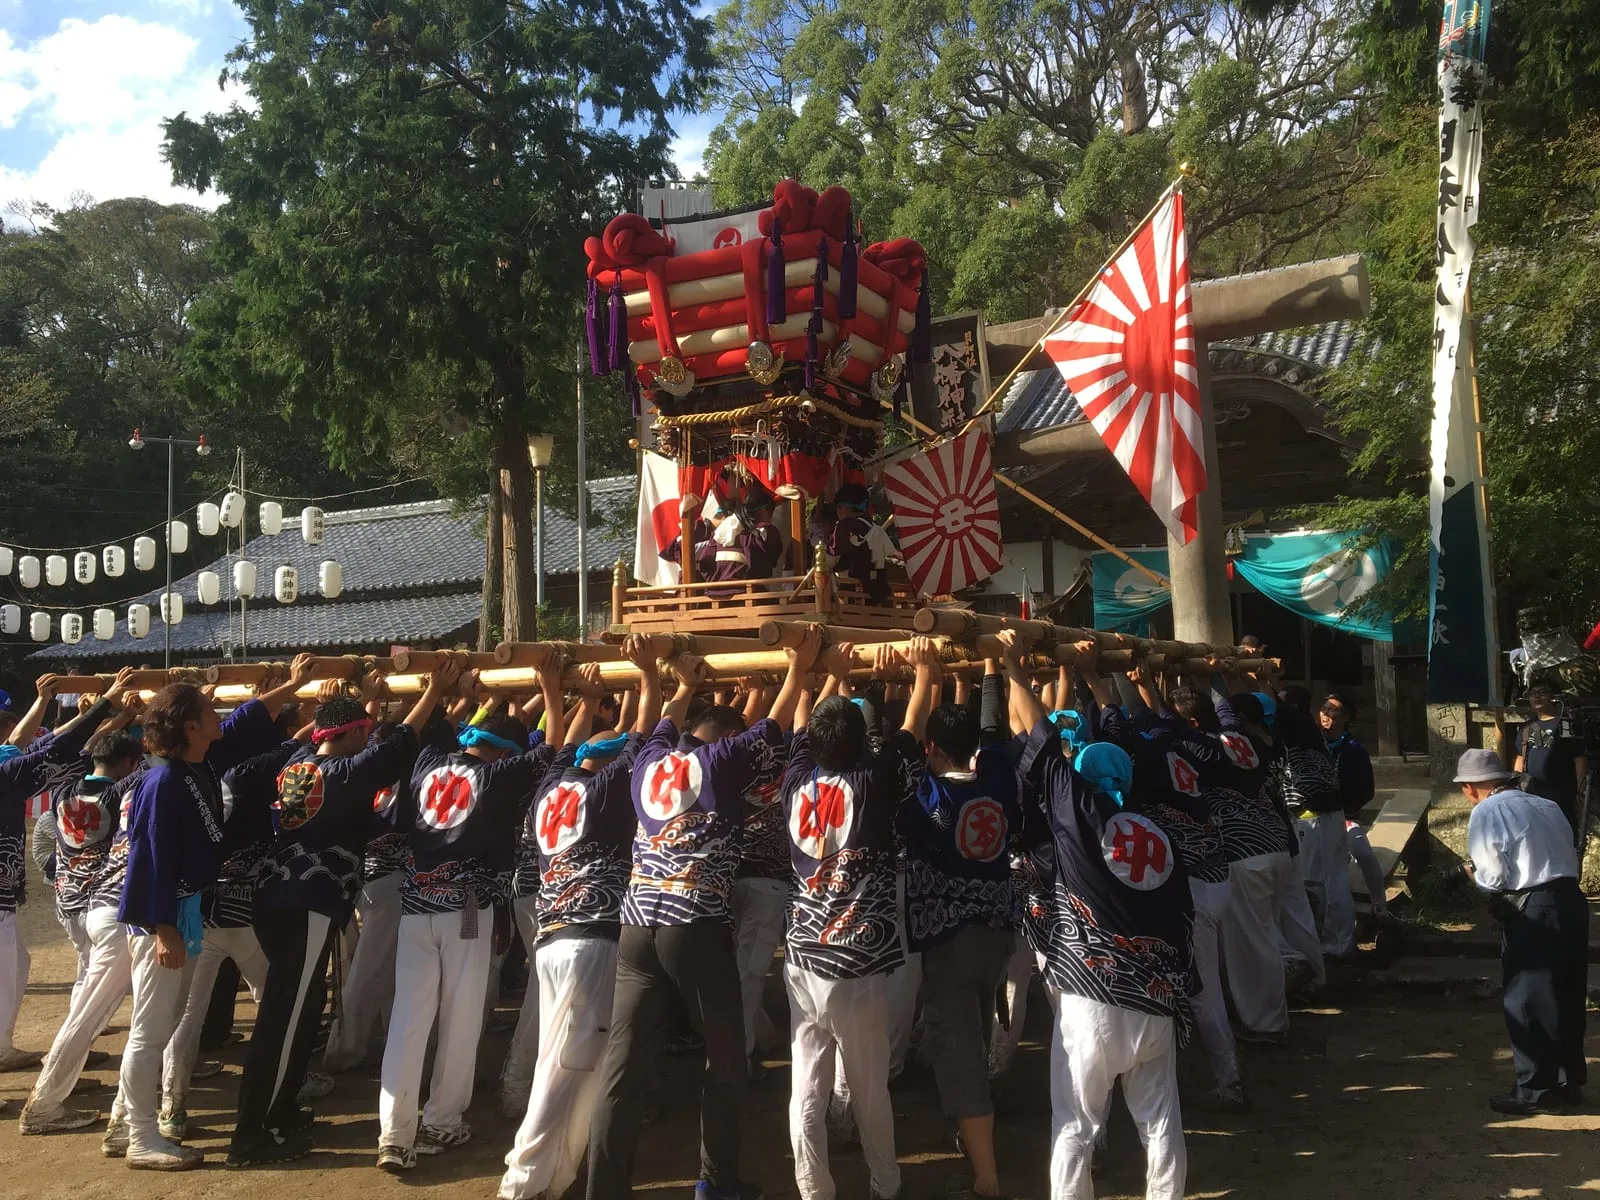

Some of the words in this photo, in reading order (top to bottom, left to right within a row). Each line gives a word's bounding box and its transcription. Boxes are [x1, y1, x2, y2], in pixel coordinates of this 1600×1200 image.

[932, 343, 966, 429] 八幡神社
[1112, 818, 1168, 884] 中
